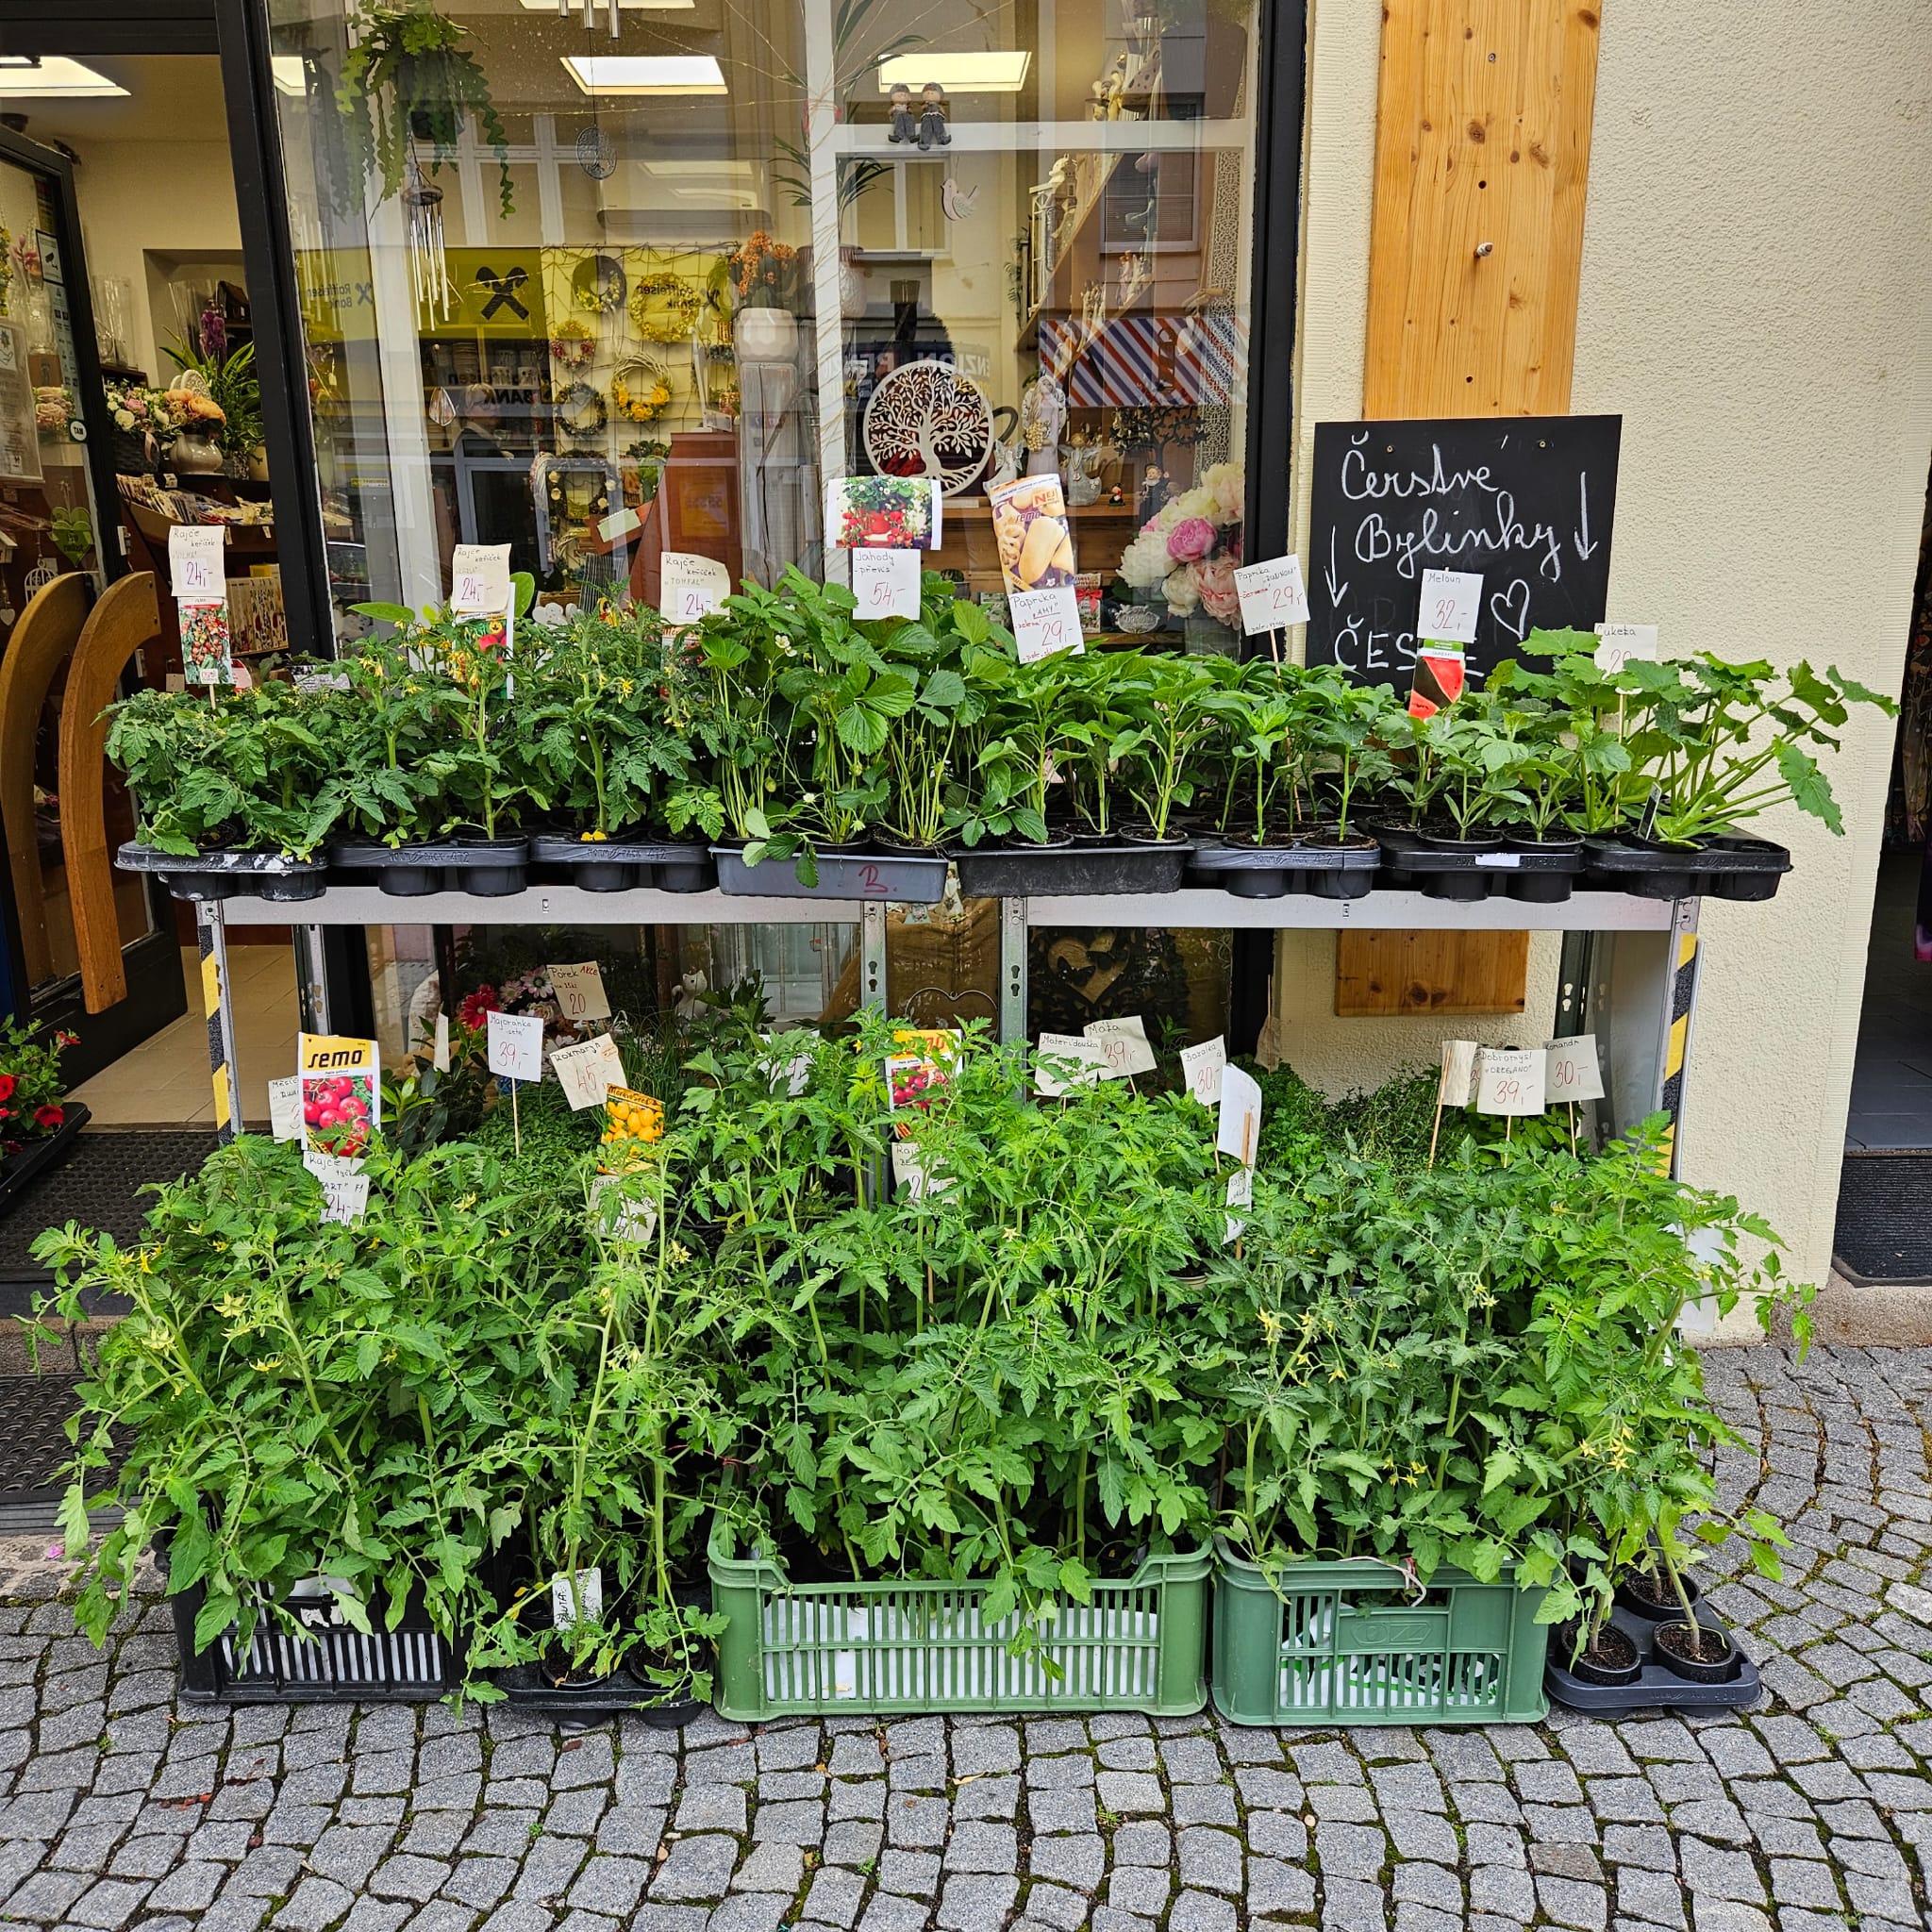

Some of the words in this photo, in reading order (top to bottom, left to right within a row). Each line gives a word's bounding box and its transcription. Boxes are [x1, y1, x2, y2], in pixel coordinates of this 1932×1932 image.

[1355, 491, 1561, 582] Bylinky
[855, 551, 894, 567] Jahody
[1427, 573, 1461, 584] Meloun
[1011, 592, 1057, 610] Paprika
[569, 992, 587, 1016] 20
[308, 1049, 362, 1068] semo
